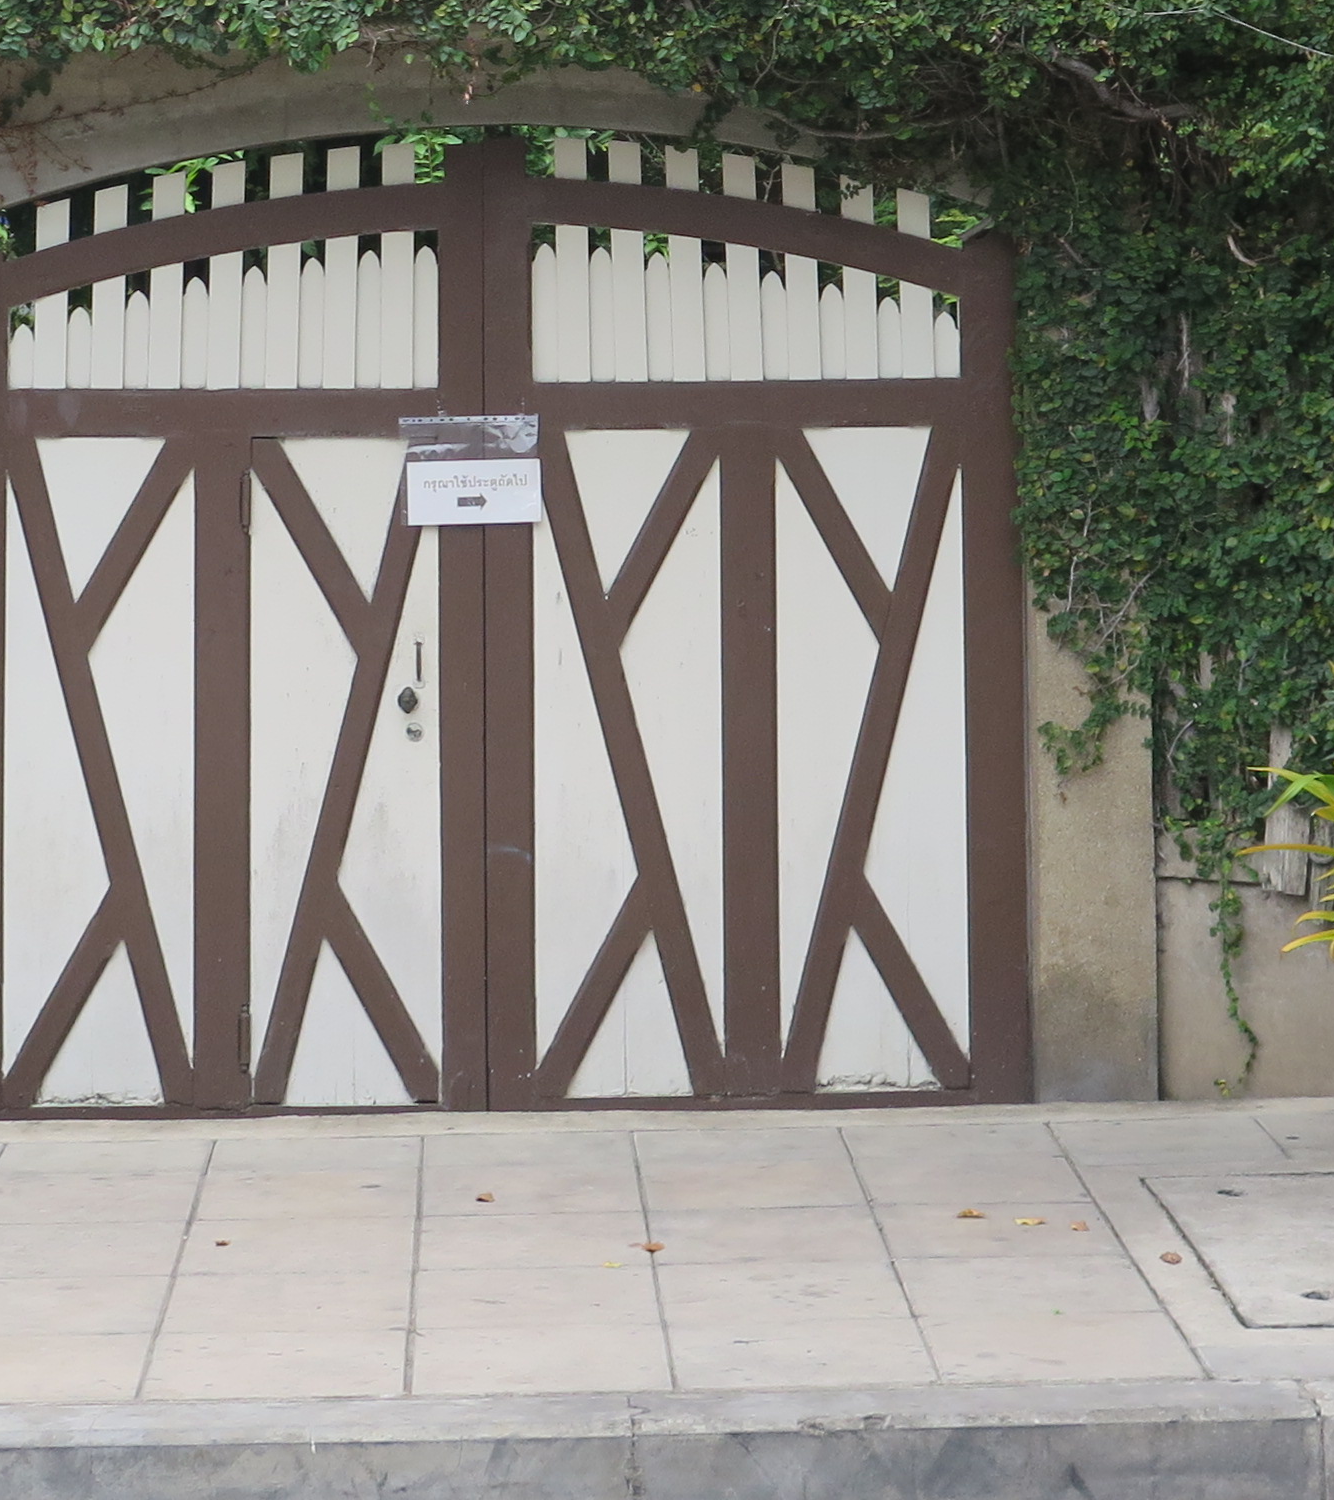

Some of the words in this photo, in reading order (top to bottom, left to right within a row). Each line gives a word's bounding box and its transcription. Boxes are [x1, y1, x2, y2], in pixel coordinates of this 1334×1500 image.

[423, 473, 528, 493] กรุณาใช้ประตูถัดไป
